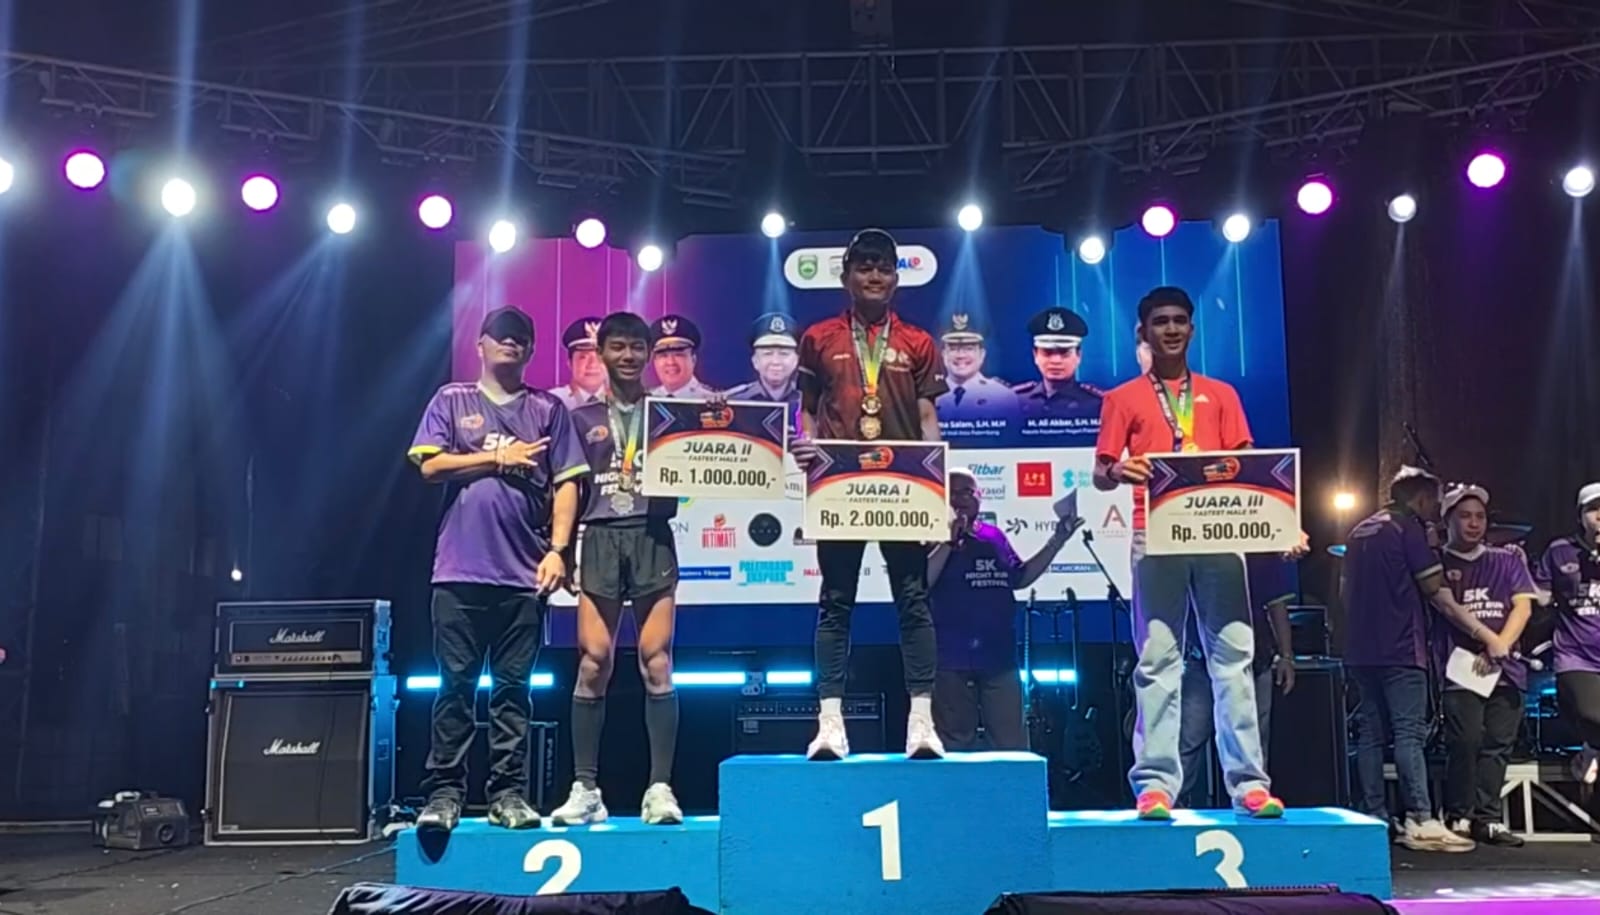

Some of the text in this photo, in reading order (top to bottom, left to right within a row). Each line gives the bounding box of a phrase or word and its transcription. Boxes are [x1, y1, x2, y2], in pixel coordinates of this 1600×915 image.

[683, 441, 752, 455] JUARA II
[660, 467, 683, 485] Rp.
[690, 468, 776, 489] 1.000.000,-
[846, 483, 911, 496] JUARA I
[1184, 495, 1264, 509] JUARA III
[820, 510, 939, 529] Rp. 2.000.000,-
[1172, 521, 1282, 543] Rp. 500.000,-
[975, 559, 997, 571] 5K
[1463, 587, 1489, 602] 5K
[268, 627, 326, 643] Marshall
[263, 738, 321, 755] Marshall
[861, 799, 902, 880] 1
[523, 839, 582, 896] 2
